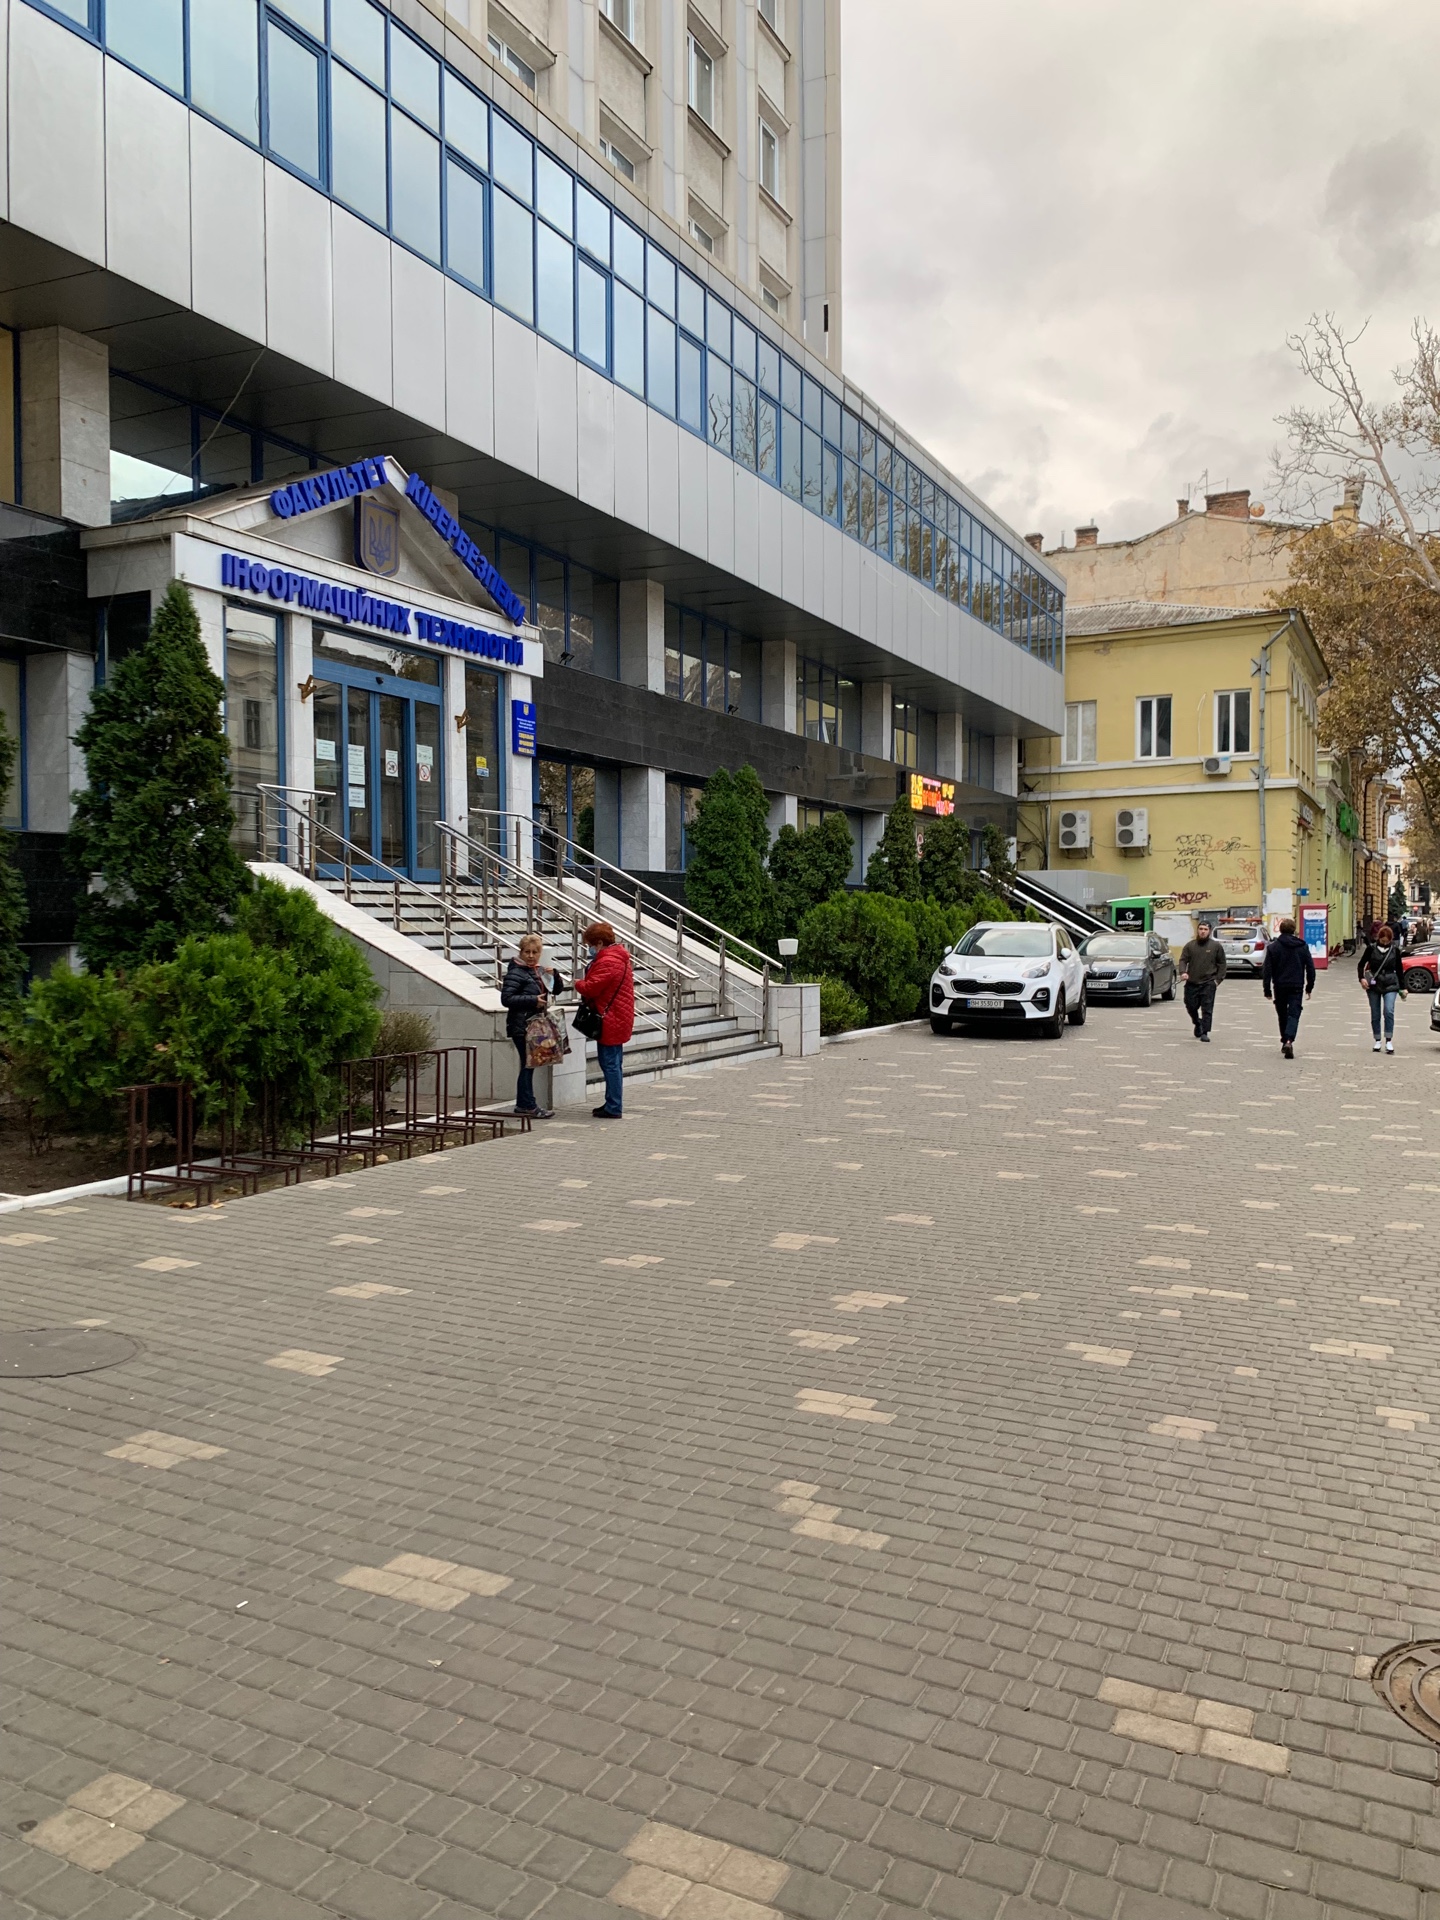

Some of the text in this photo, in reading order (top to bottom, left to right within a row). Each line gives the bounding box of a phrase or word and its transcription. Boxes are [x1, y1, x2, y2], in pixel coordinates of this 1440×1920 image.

[269, 455, 388, 519] ФАКУЛЬТЕТ
[405, 472, 525, 627] КІБЕРБЕЗПЕКИ
[221, 553, 524, 666] ІНФОРМАЦІЙНИХ ТЕХНОЛОГІЙ
